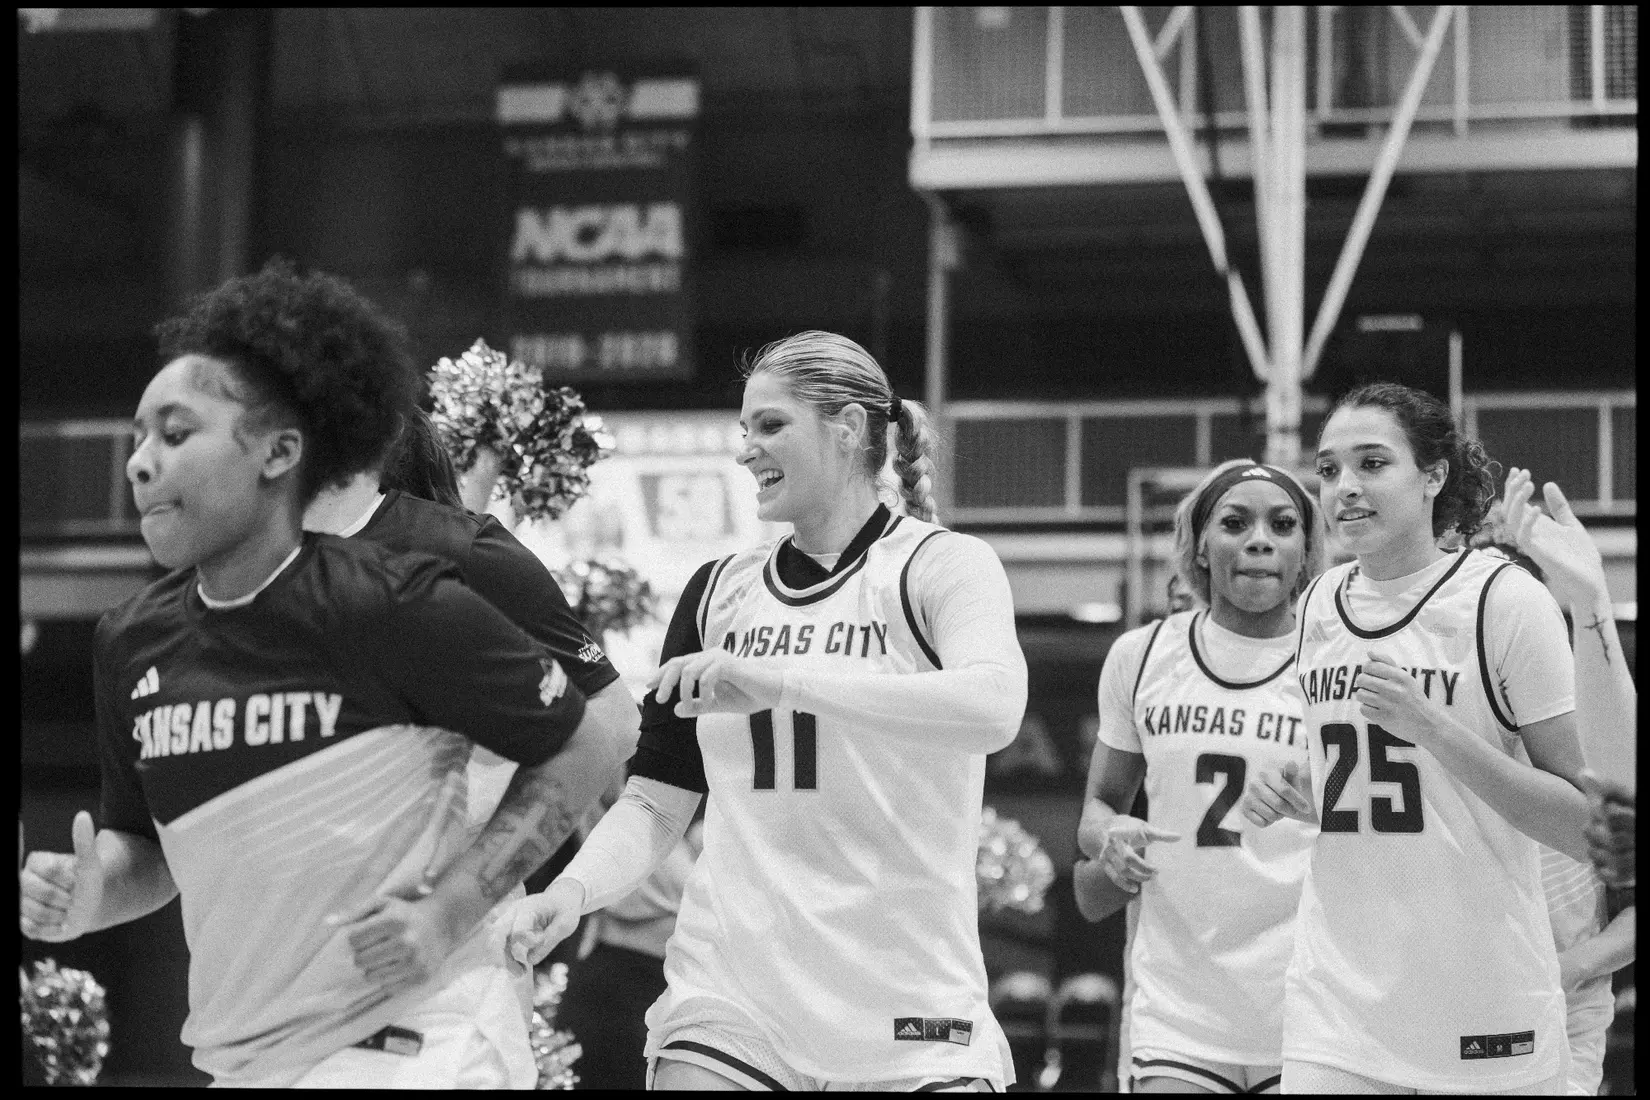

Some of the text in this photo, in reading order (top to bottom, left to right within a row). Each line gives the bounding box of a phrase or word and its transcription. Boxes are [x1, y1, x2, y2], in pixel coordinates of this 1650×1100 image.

[512, 204, 683, 261] NCAA
[722, 620, 888, 658] ANSAS CITY
[1299, 665, 1363, 706] KANSA
[244, 691, 343, 746] CITY
[1144, 705, 1308, 749] KANSAS CIT
[1195, 752, 1248, 847] 2
[1319, 721, 1425, 834] 25
